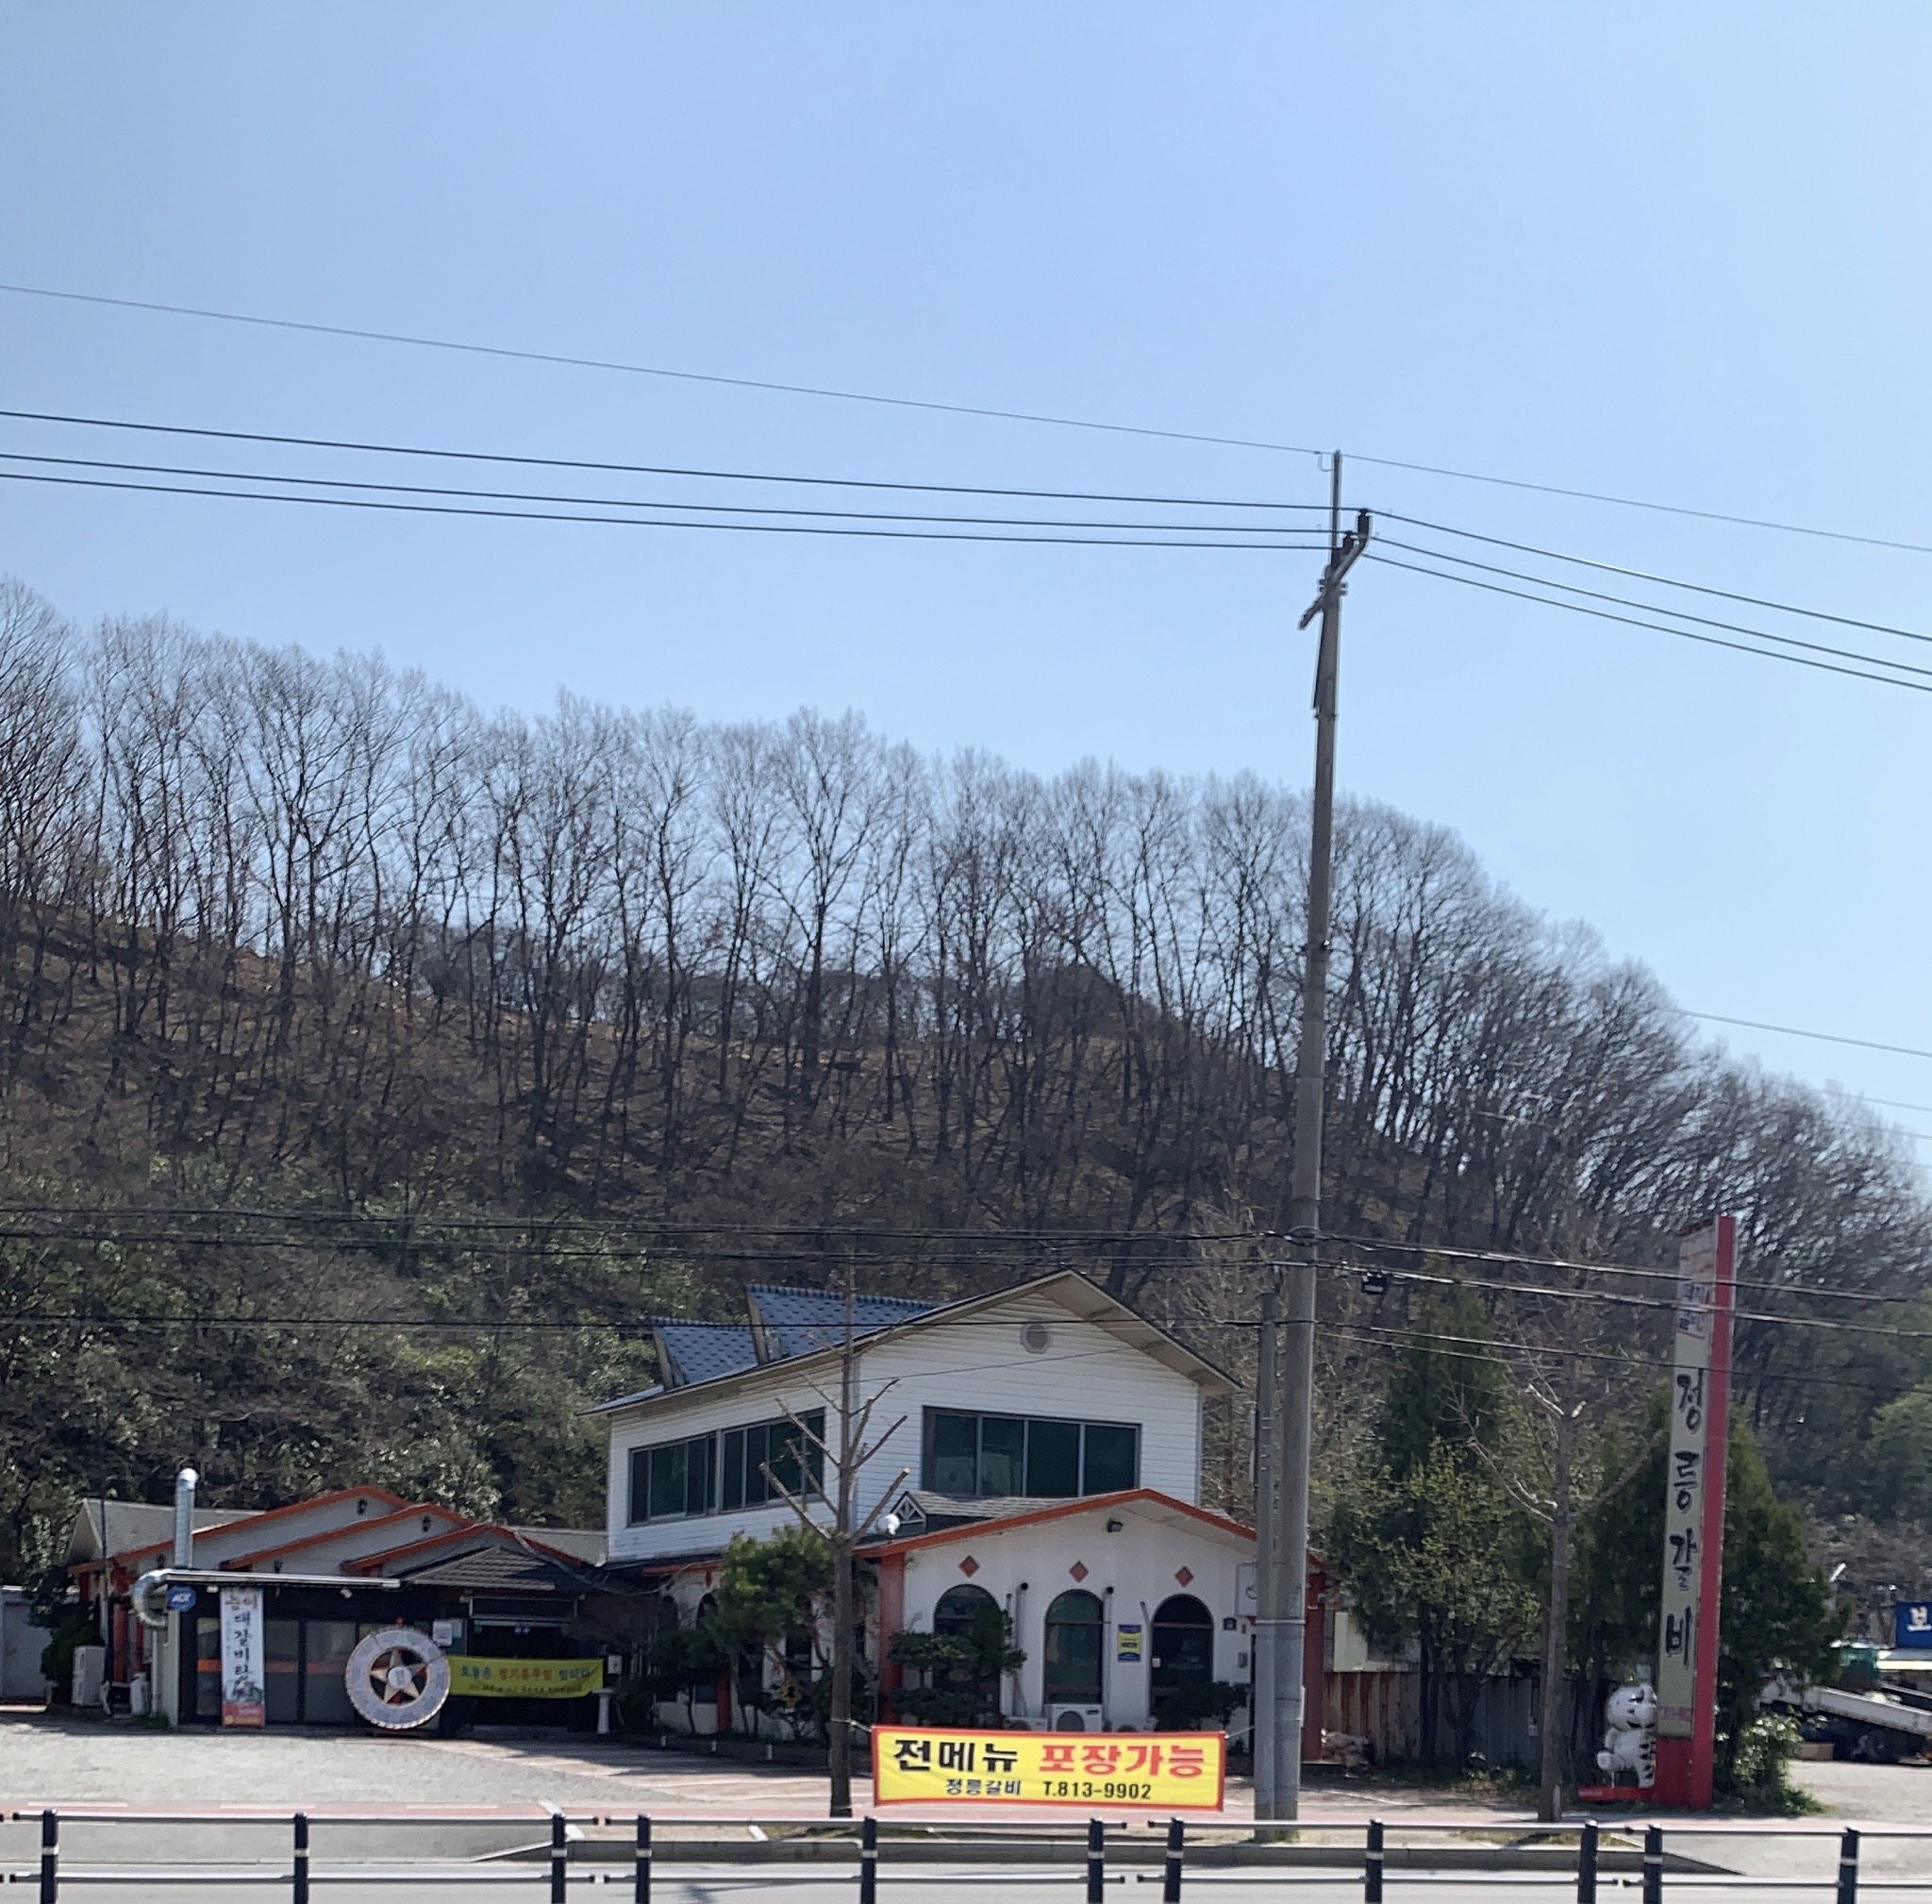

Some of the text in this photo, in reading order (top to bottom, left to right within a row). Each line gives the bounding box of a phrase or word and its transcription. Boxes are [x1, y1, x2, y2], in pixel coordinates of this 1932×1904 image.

[893, 1739, 1205, 1778] 전메뉴 포장가능
[945, 1778, 1022, 1796] 정릉갈비
